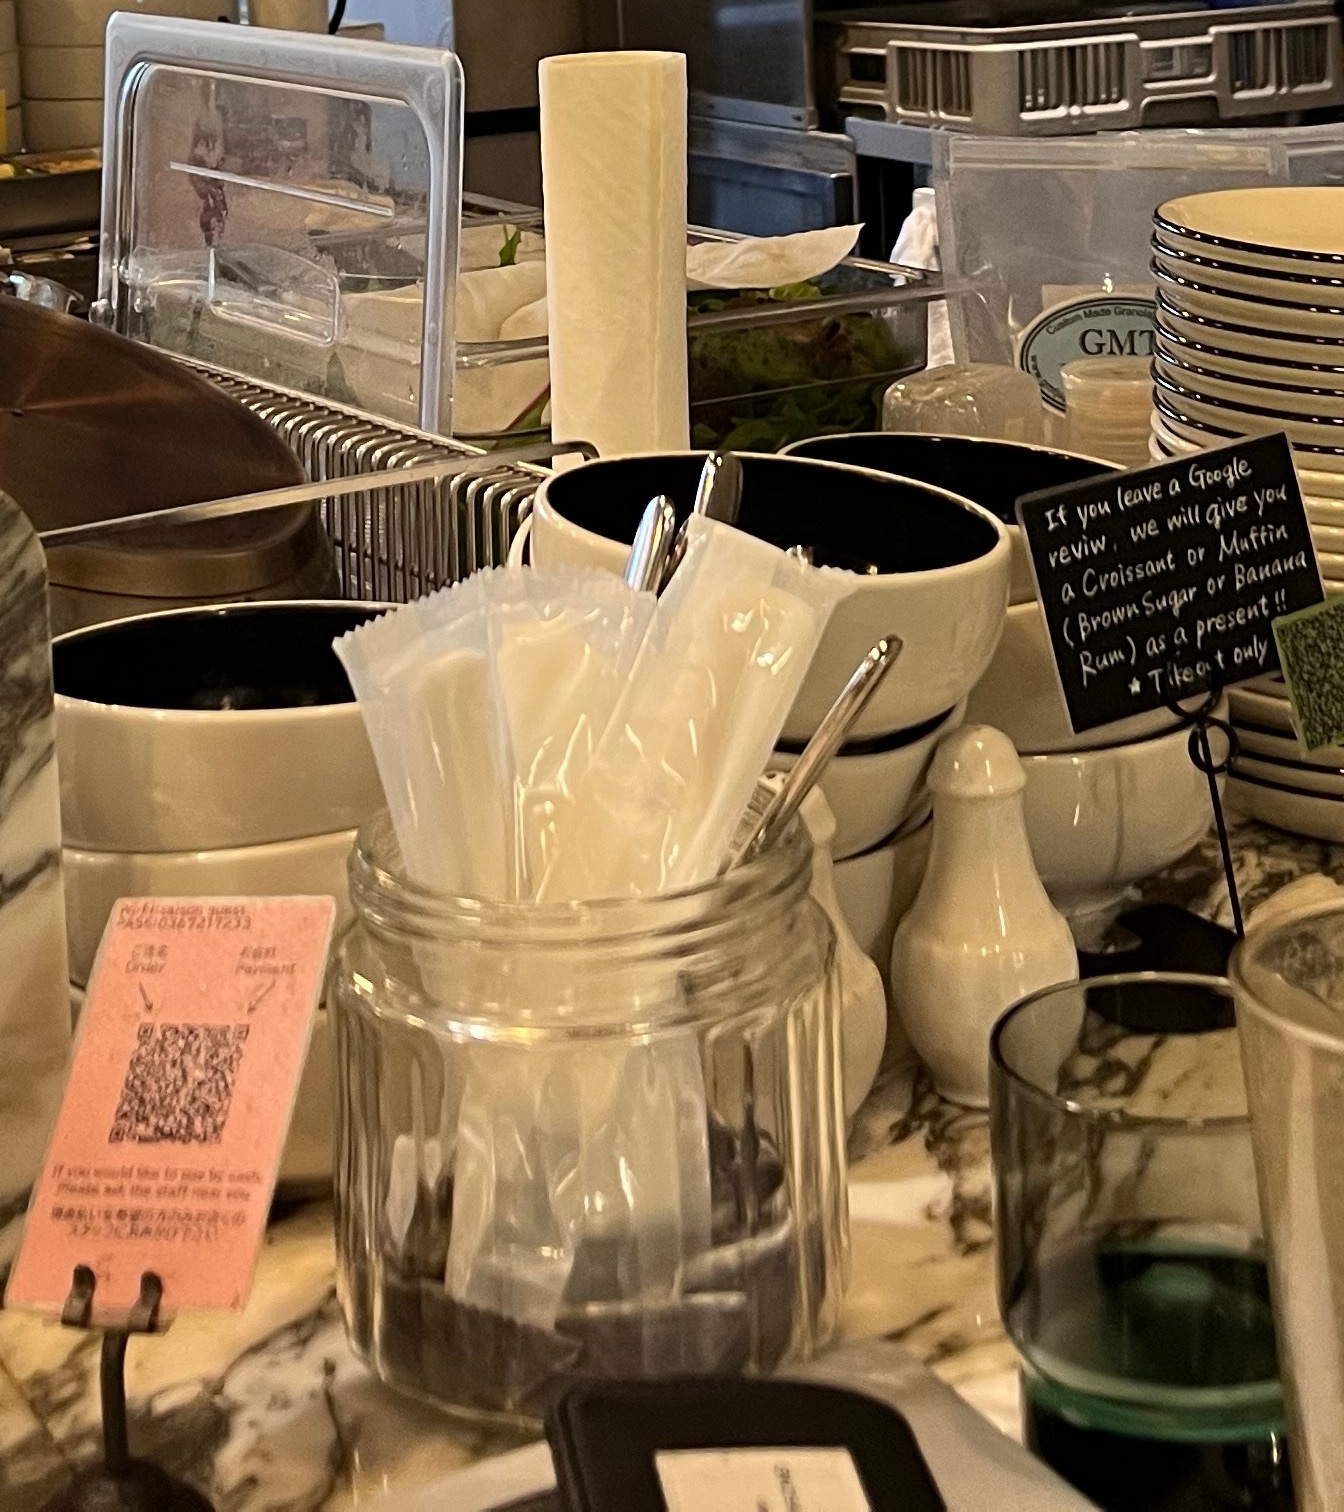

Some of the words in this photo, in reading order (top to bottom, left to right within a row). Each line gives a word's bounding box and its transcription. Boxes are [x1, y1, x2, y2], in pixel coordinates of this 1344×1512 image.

[1045, 503, 1067, 532] If
[1077, 500, 1111, 531] you
[1117, 482, 1163, 512] leave
[1169, 478, 1181, 496] a
[1189, 456, 1252, 489] Google
[1130, 519, 1159, 543] we
[1167, 504, 1200, 532] will
[1206, 496, 1248, 531] give
[1254, 483, 1287, 518] you
[1062, 582, 1076, 605] a
[1083, 549, 1175, 597] Croissant
[1187, 546, 1205, 567] or
[1218, 524, 1289, 563] Muffin
[1207, 574, 1225, 595] or
[1235, 550, 1308, 591] Banana
[1079, 635, 1136, 688] Rum)
[1146, 634, 1166, 657] as
[1174, 626, 1188, 645] a
[1234, 634, 1268, 666] only
